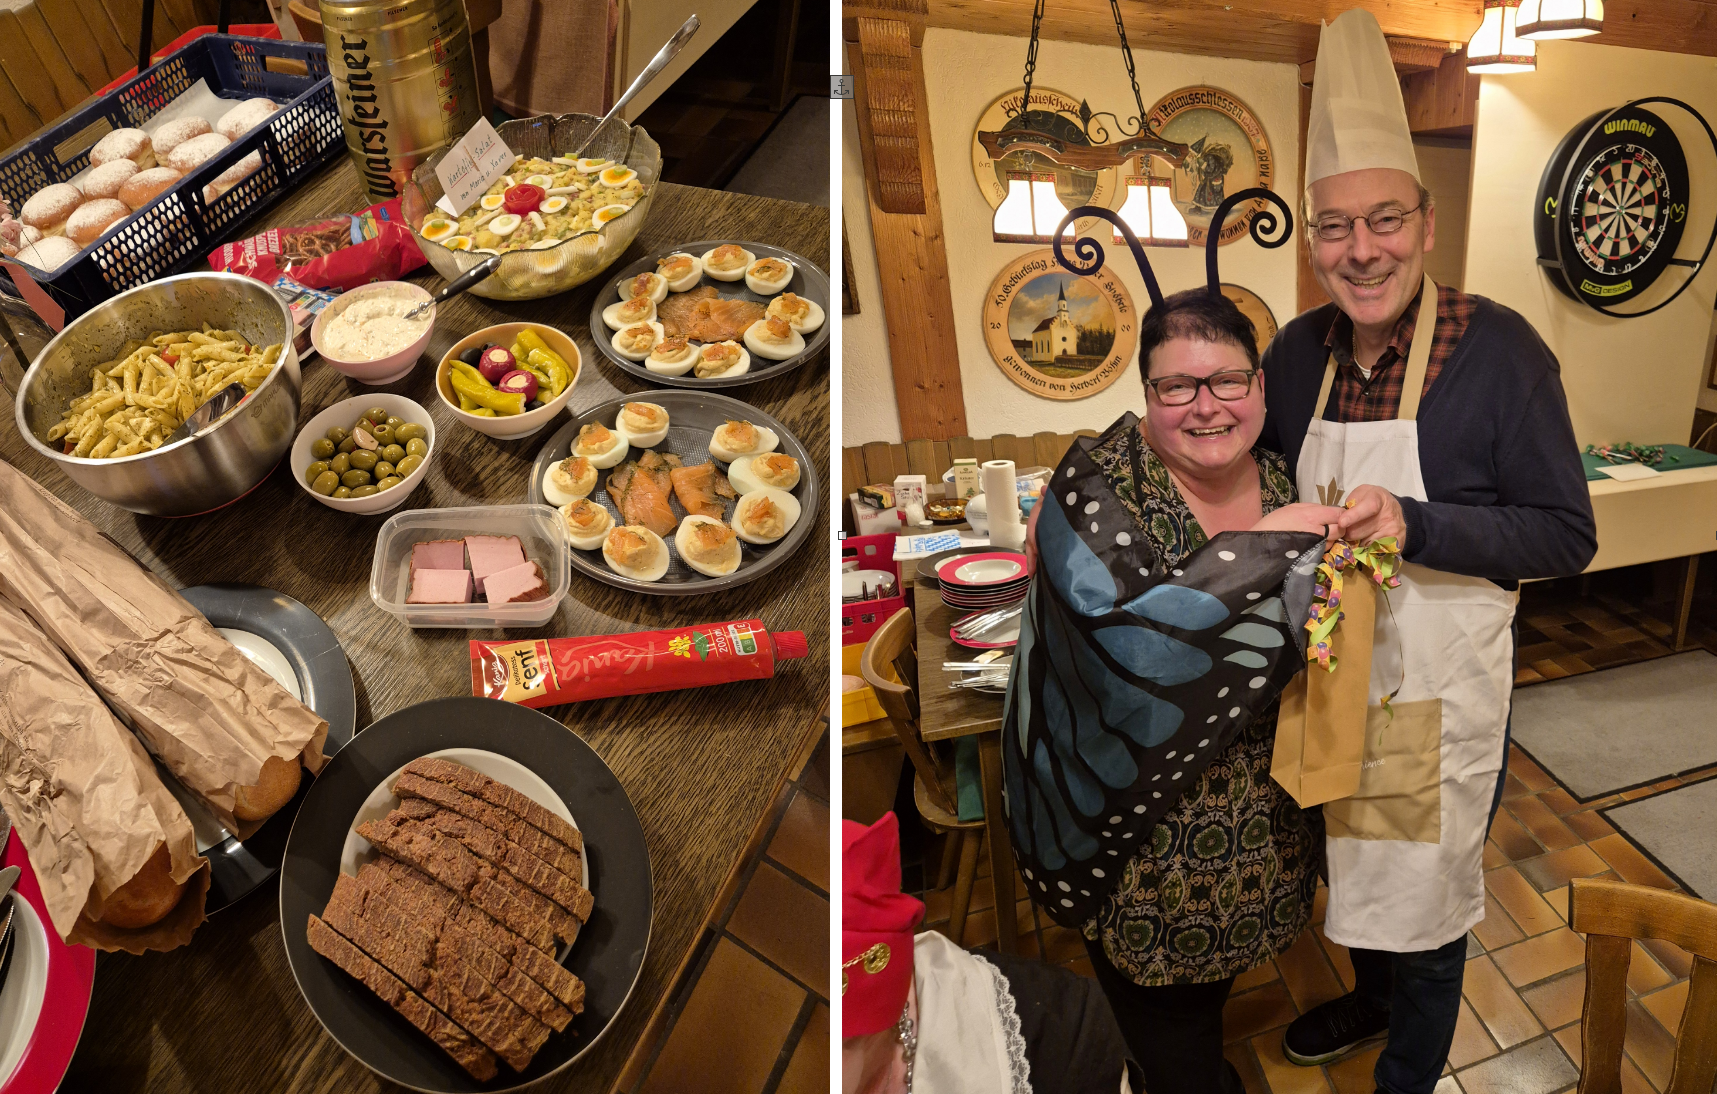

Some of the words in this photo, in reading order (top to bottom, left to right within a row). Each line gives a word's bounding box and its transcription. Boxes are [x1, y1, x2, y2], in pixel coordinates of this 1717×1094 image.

[1604, 119, 1655, 137] WINMAU
[1049, 383, 1066, 392] von
[716, 637, 728, 653] 200
